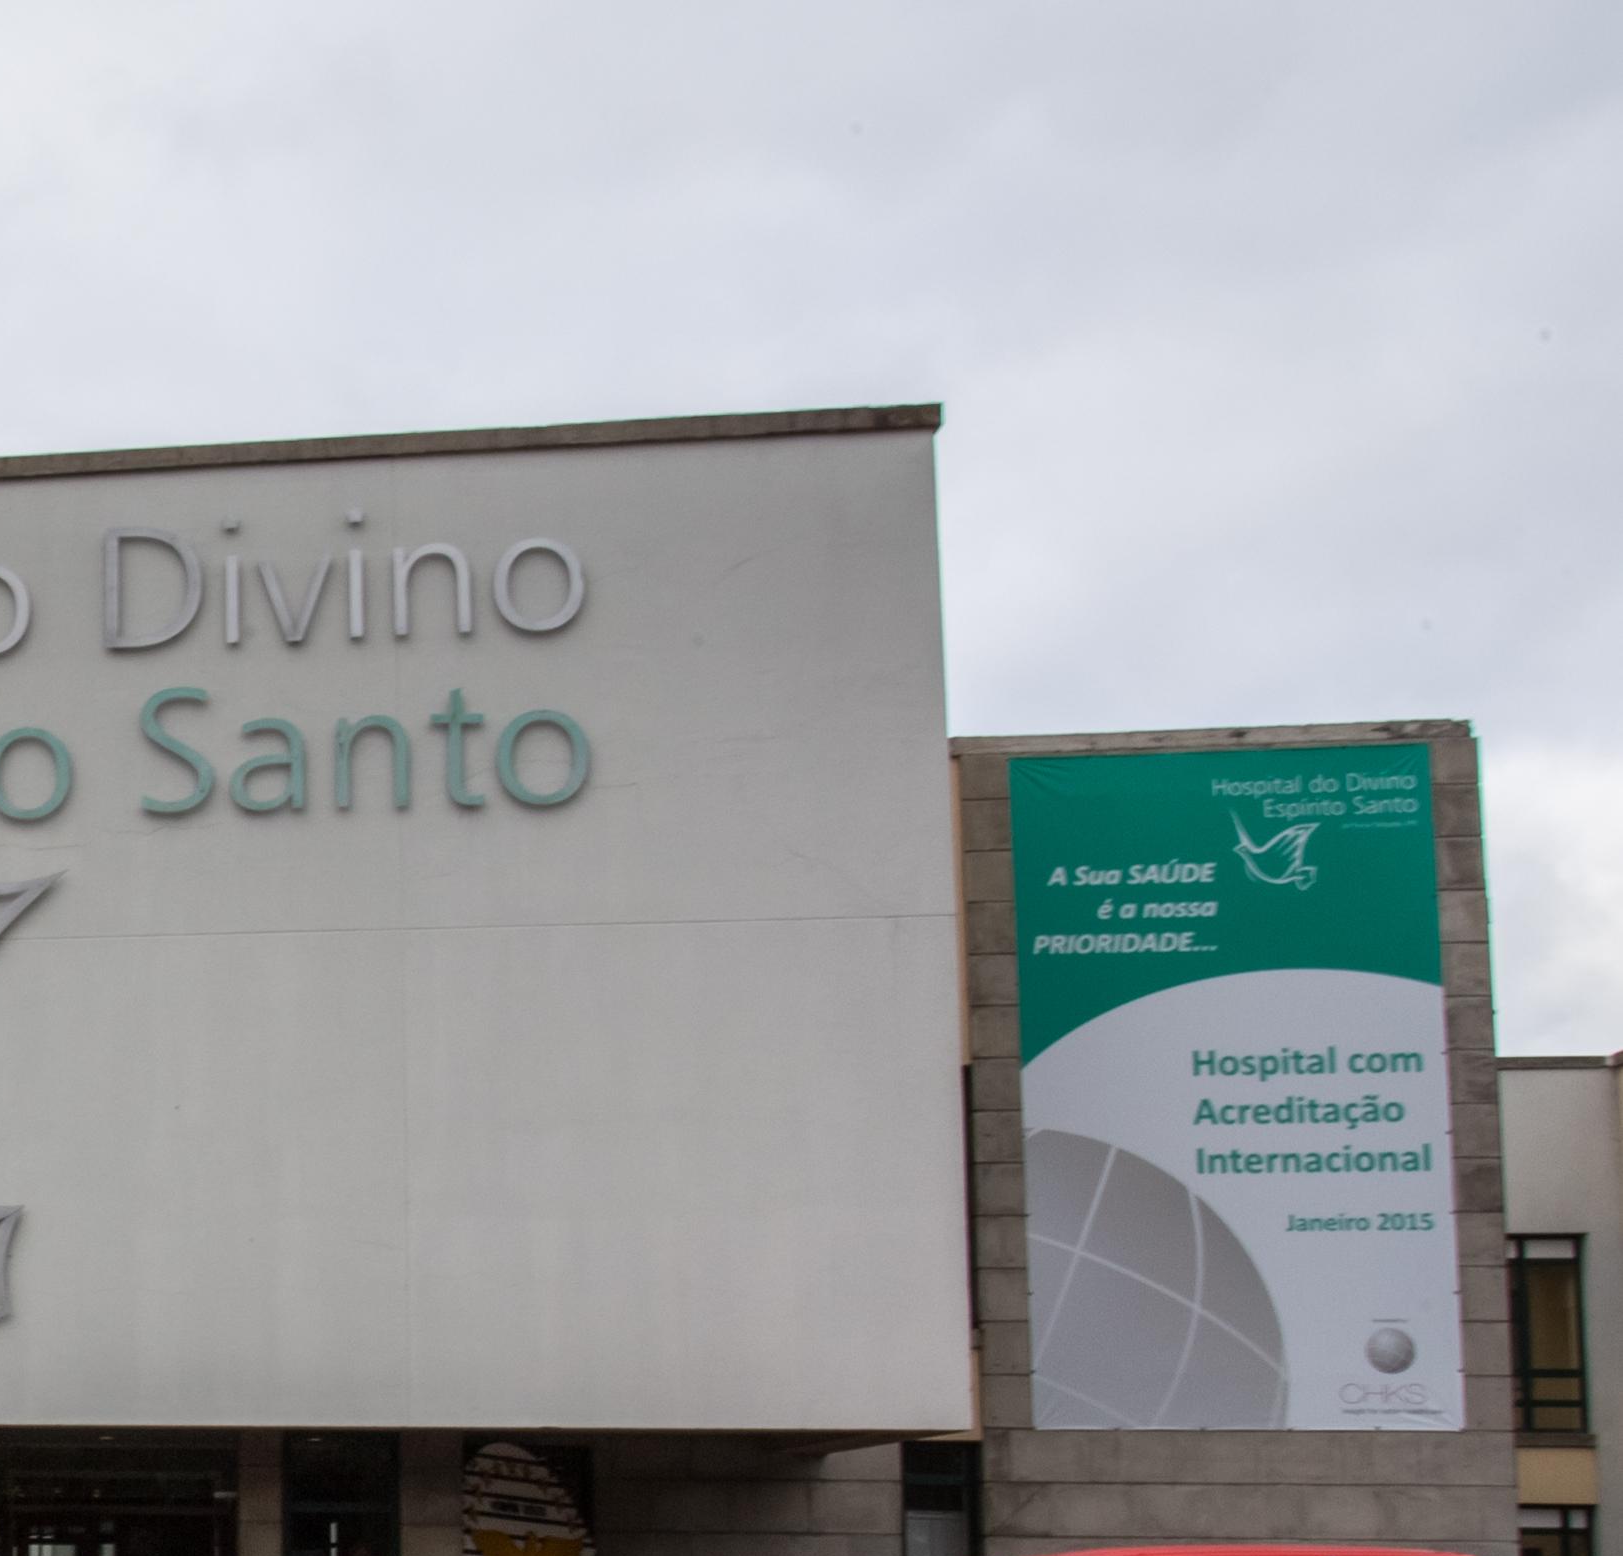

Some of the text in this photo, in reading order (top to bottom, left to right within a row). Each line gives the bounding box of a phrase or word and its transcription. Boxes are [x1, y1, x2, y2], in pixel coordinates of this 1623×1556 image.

[100, 512, 589, 653] Divino
[136, 685, 594, 817] Santo
[1211, 772, 1418, 798] Hospital do Divino
[1351, 795, 1420, 815] Santo
[1047, 858, 1217, 886] A Sua SAÚDE
[1096, 898, 1219, 920] é a nossa
[1032, 932, 1218, 955] PRIORIDADE...
[1191, 1045, 1425, 1083] Hospital com
[1192, 1094, 1406, 1131] Acreditação
[1195, 1142, 1433, 1175] Internacional
[1285, 1212, 1435, 1233] Janeiro 2015
